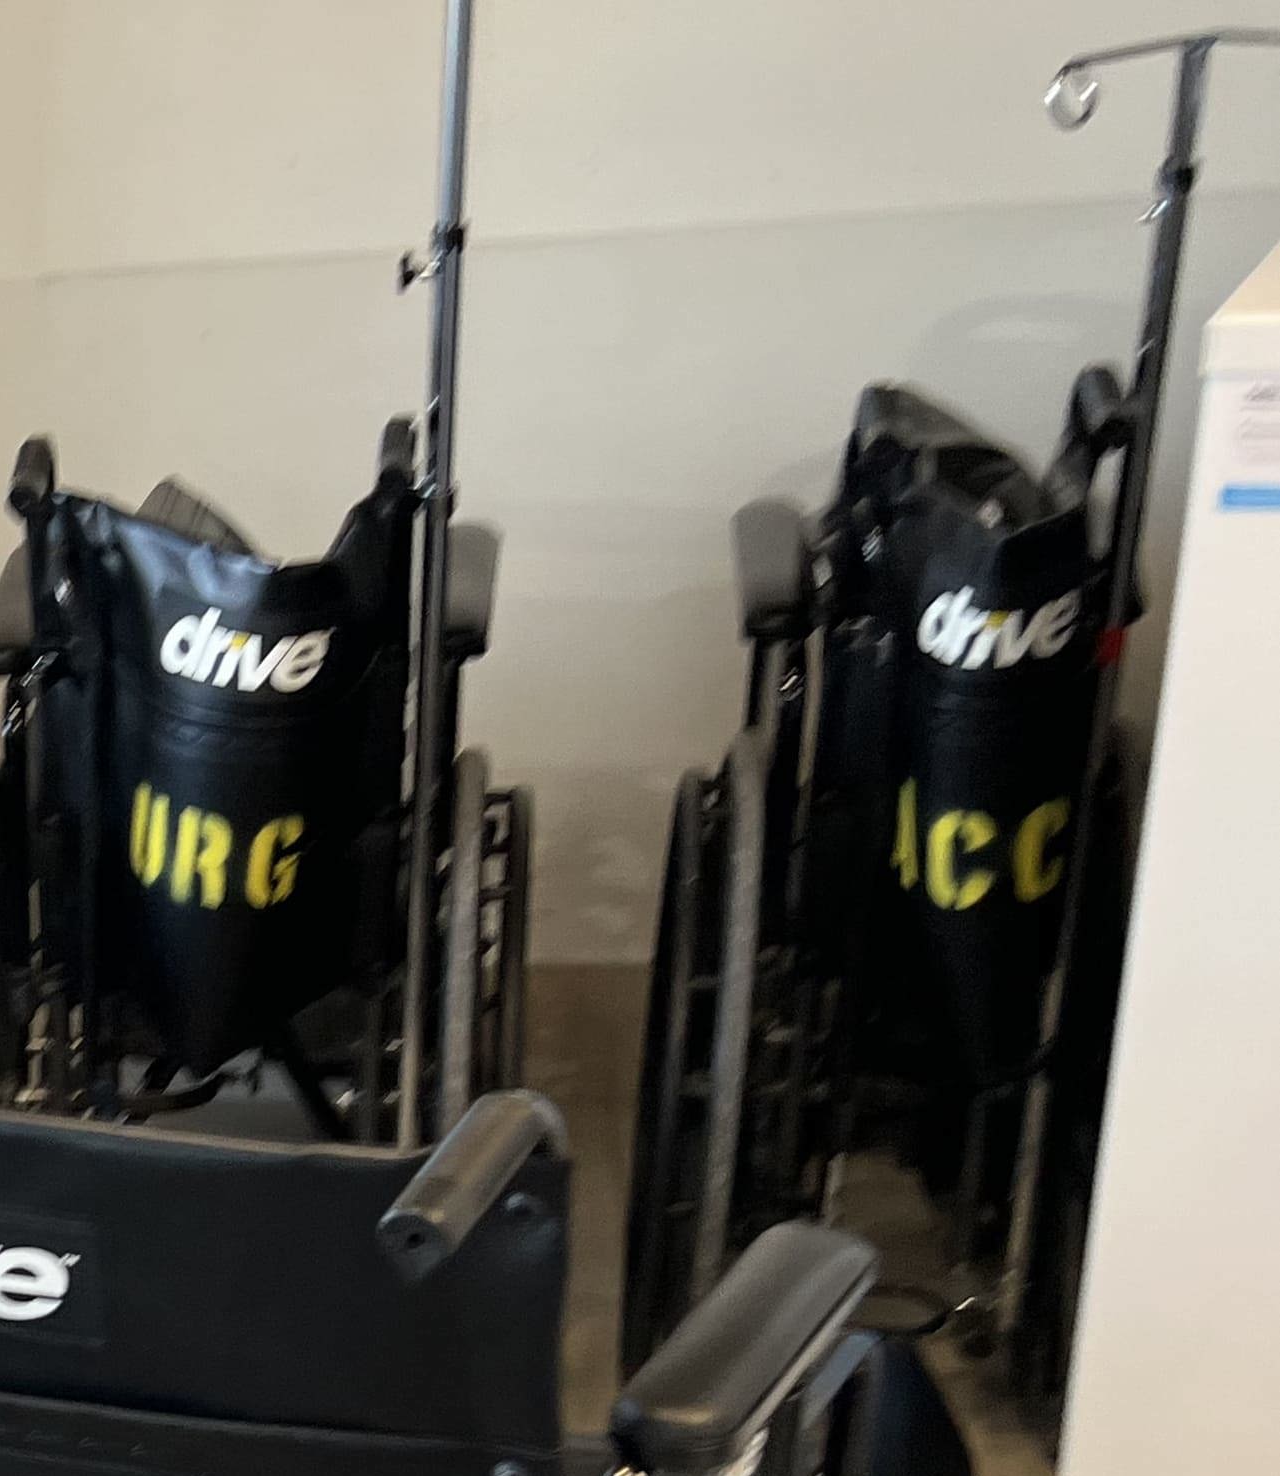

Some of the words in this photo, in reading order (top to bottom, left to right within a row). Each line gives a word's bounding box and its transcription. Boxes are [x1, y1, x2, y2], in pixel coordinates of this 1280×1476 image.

[160, 606, 330, 694] drive
[917, 585, 1081, 669] drive
[129, 781, 304, 910] URG
